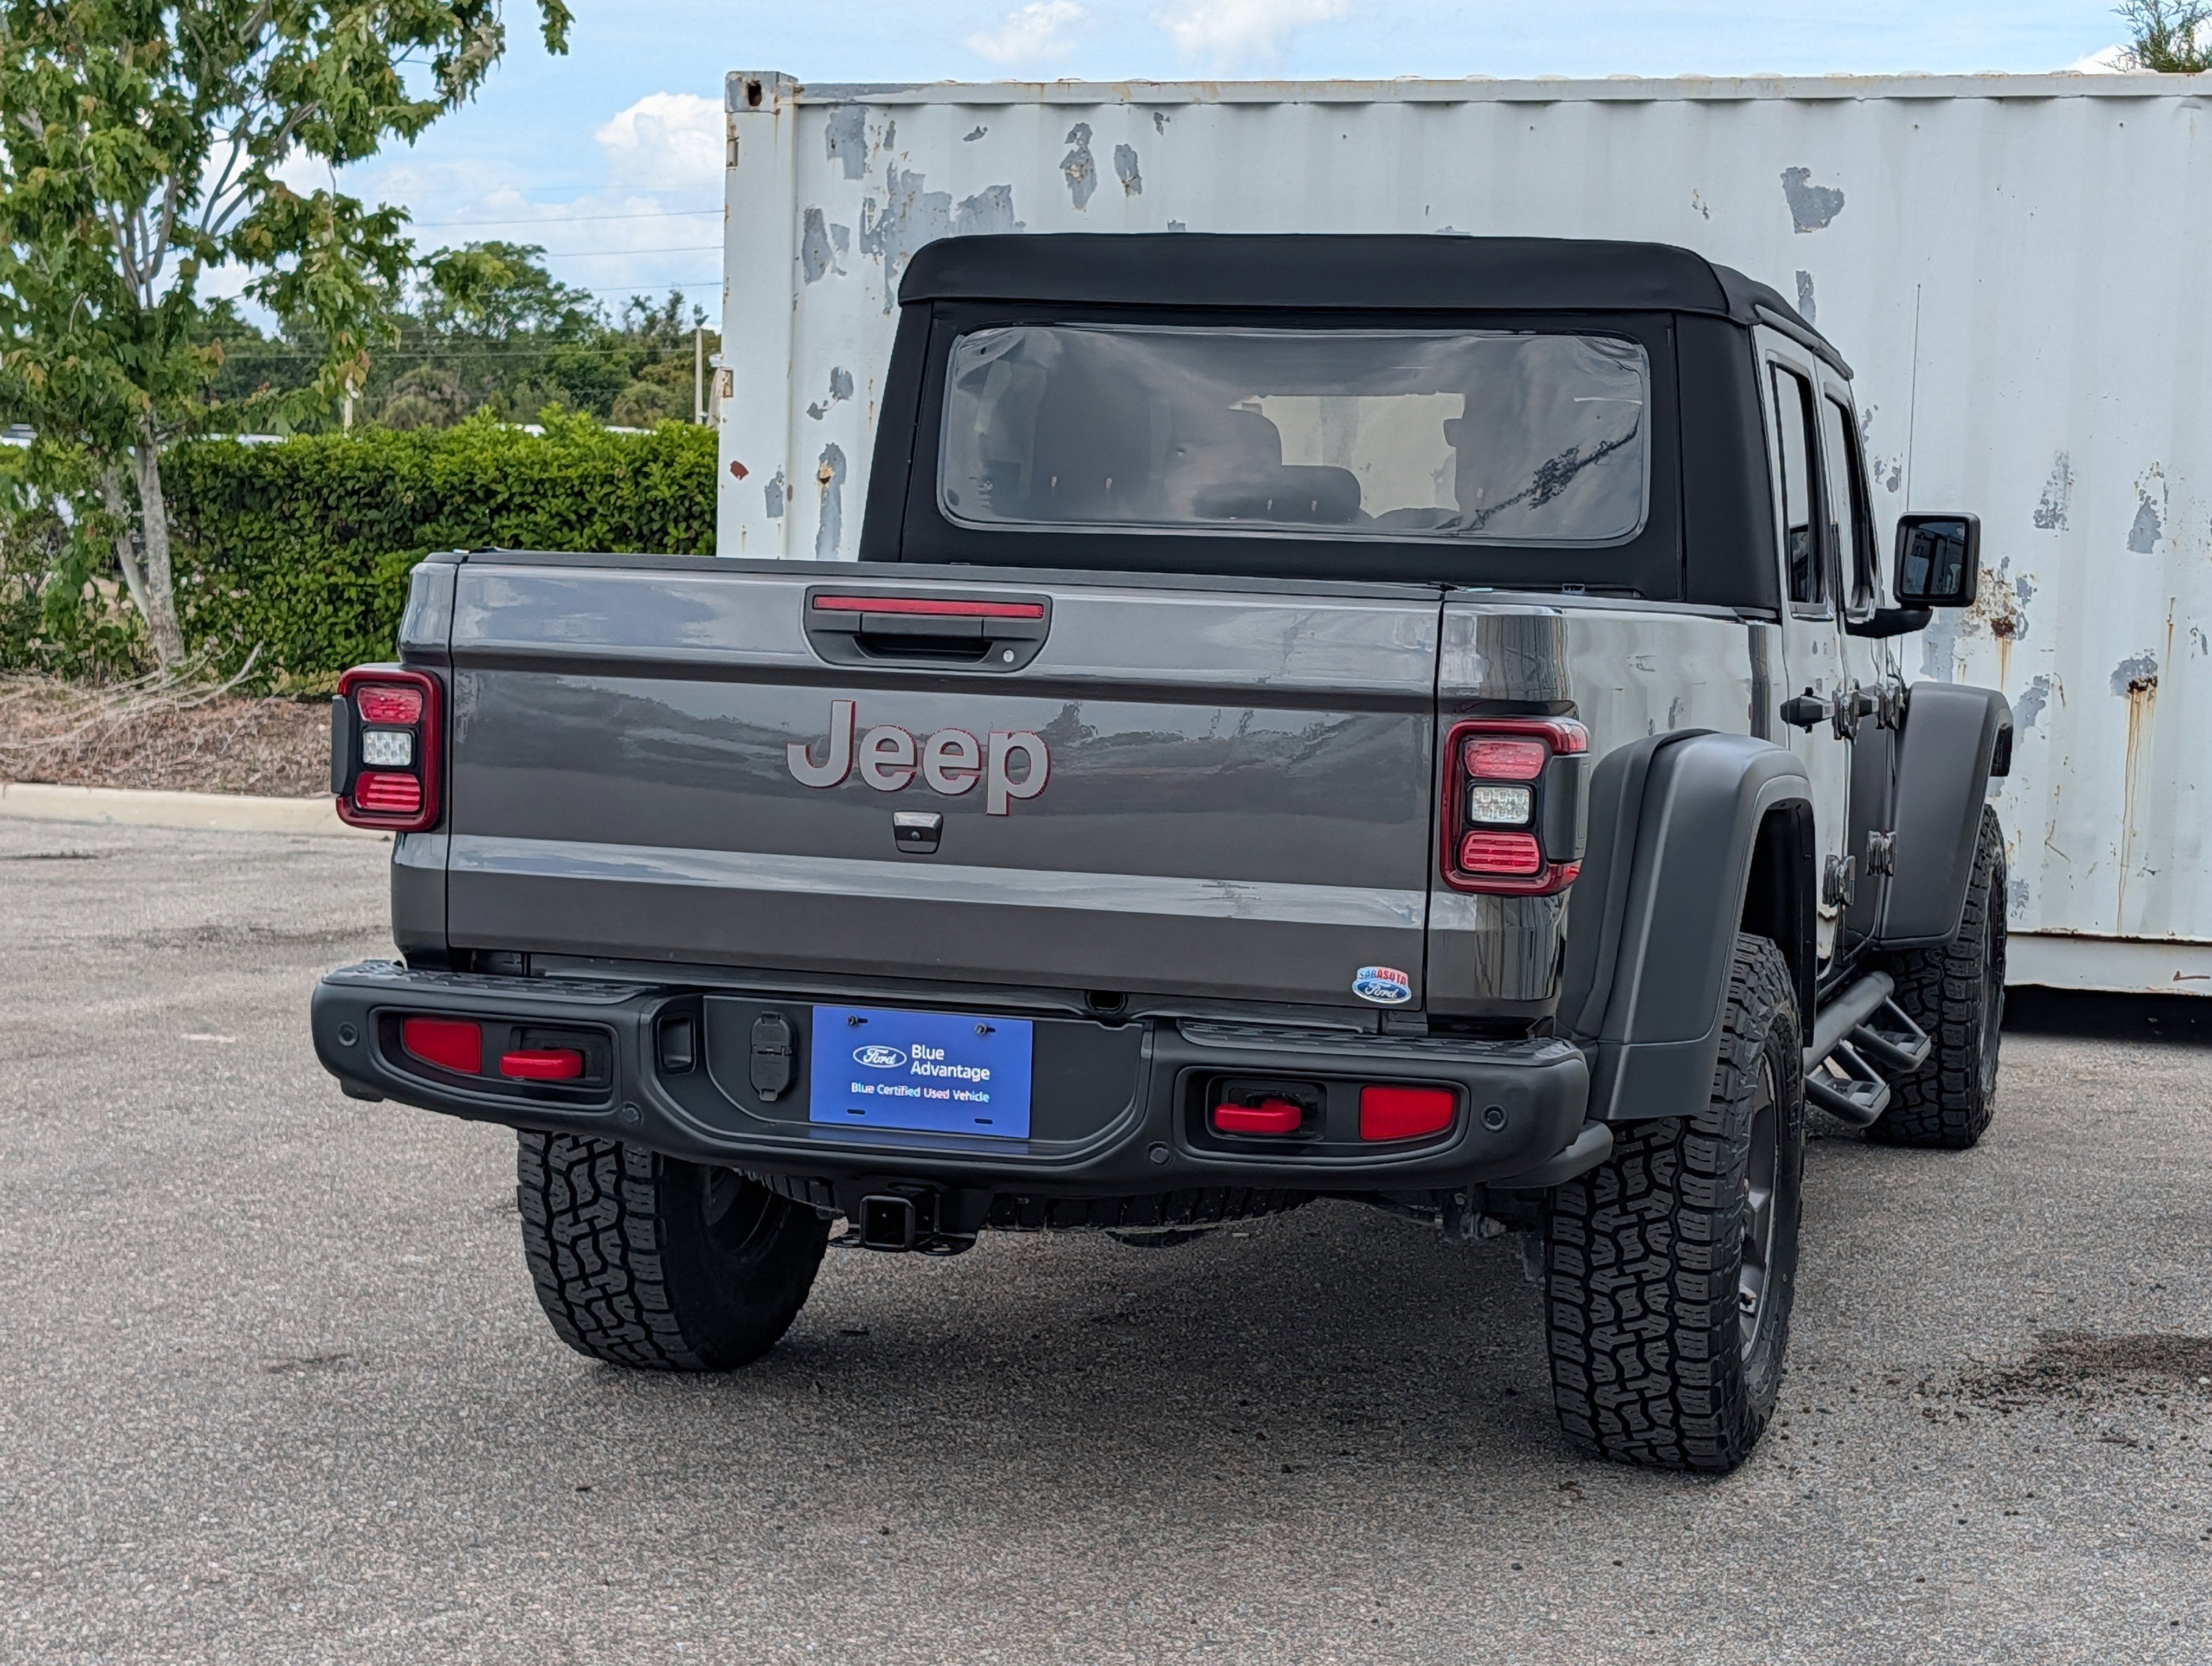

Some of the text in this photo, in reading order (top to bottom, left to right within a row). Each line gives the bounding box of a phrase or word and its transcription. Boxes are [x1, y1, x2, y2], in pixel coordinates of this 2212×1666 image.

[787, 699, 1052, 816] Jeep
[1359, 969, 1406, 985] SARASOTA
[1364, 983, 1399, 998] Ford
[863, 1048, 897, 1065] Ford
[911, 1044, 944, 1060] Blue
[910, 1061, 991, 1082] Advantage
[851, 1082, 991, 1103] Blue Certified Used Vehicle
